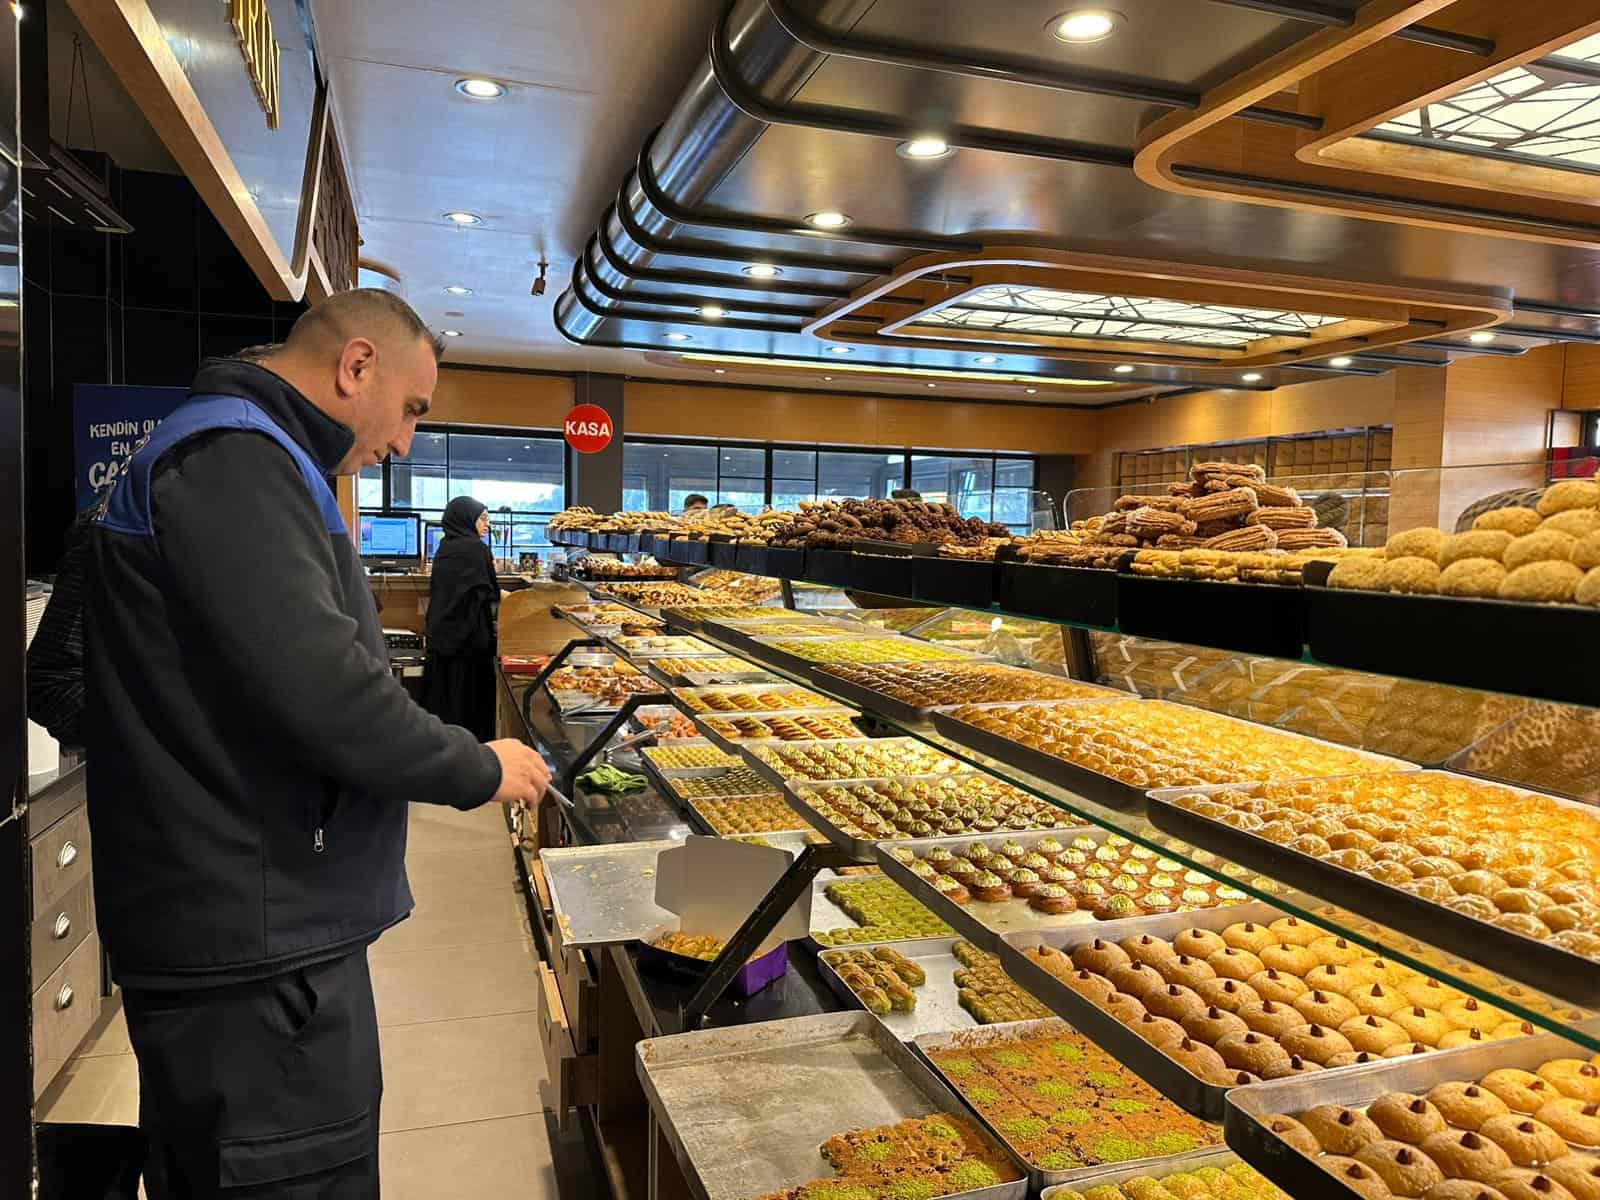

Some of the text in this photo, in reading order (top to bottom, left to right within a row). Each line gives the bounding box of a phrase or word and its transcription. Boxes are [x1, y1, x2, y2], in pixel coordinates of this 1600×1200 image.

[90, 420, 138, 438] KENDİN
[565, 420, 610, 437] KASA
[111, 441, 130, 456] EN
